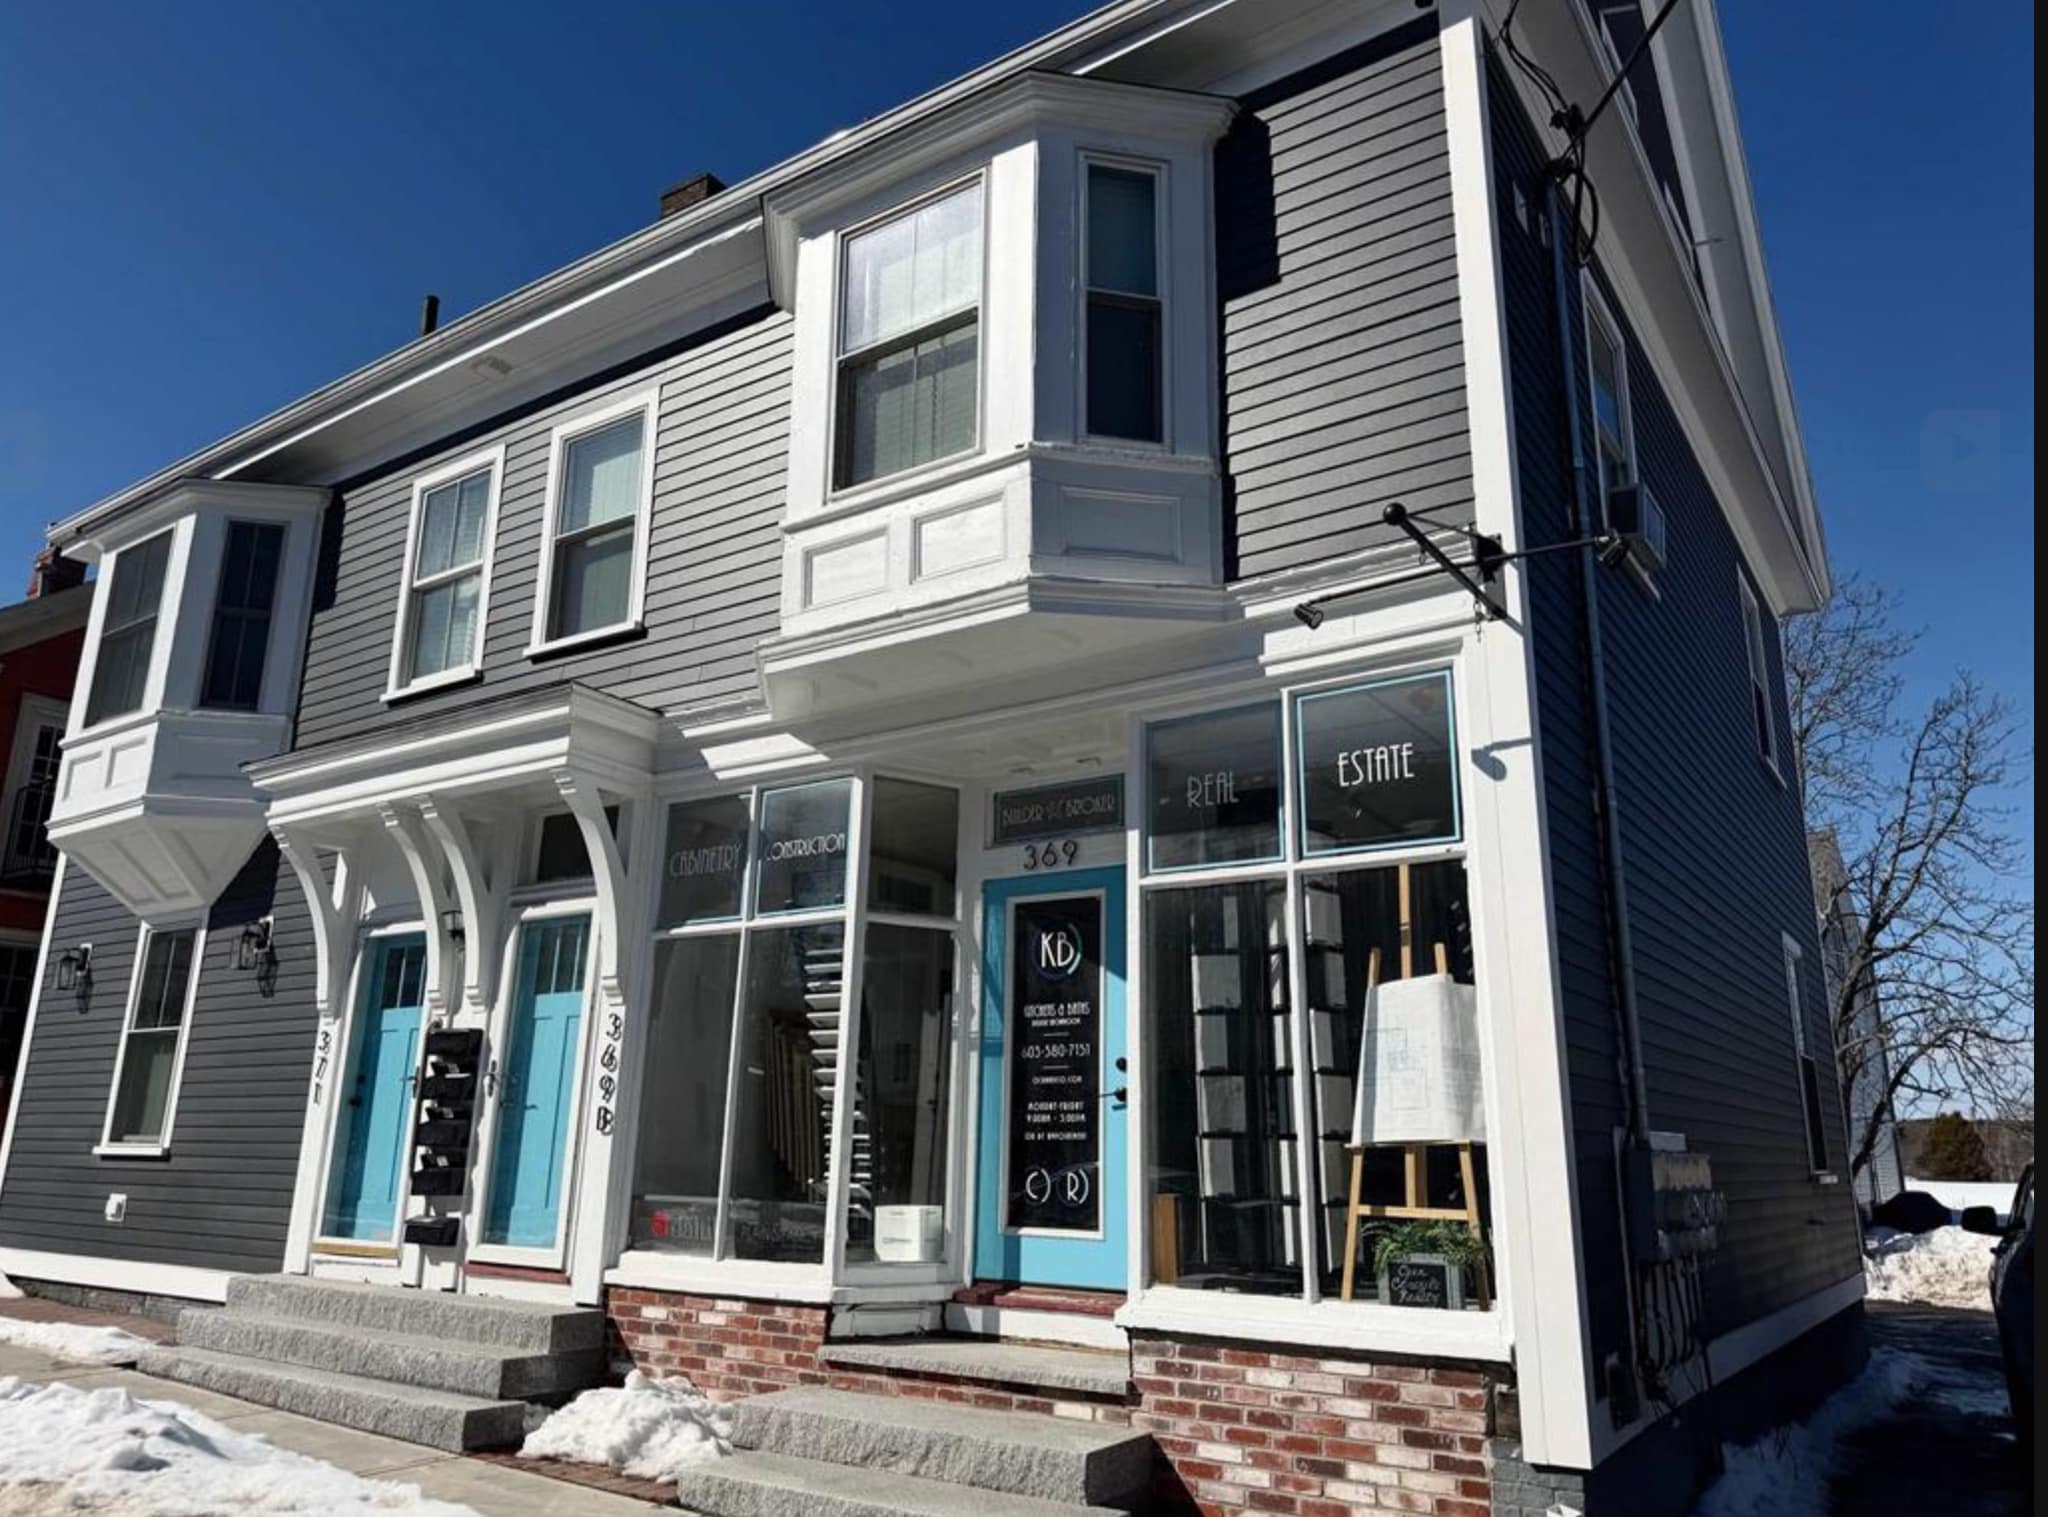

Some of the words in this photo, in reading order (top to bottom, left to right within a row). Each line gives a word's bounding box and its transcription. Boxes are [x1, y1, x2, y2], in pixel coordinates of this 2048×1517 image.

[1187, 771, 1239, 808] REAL
[1337, 742, 1415, 787] ESTATE
[1023, 839, 1079, 870] 369
[1041, 931, 1075, 968] KB
[312, 1031, 331, 1105] 371
[596, 1013, 622, 1136] 369B
